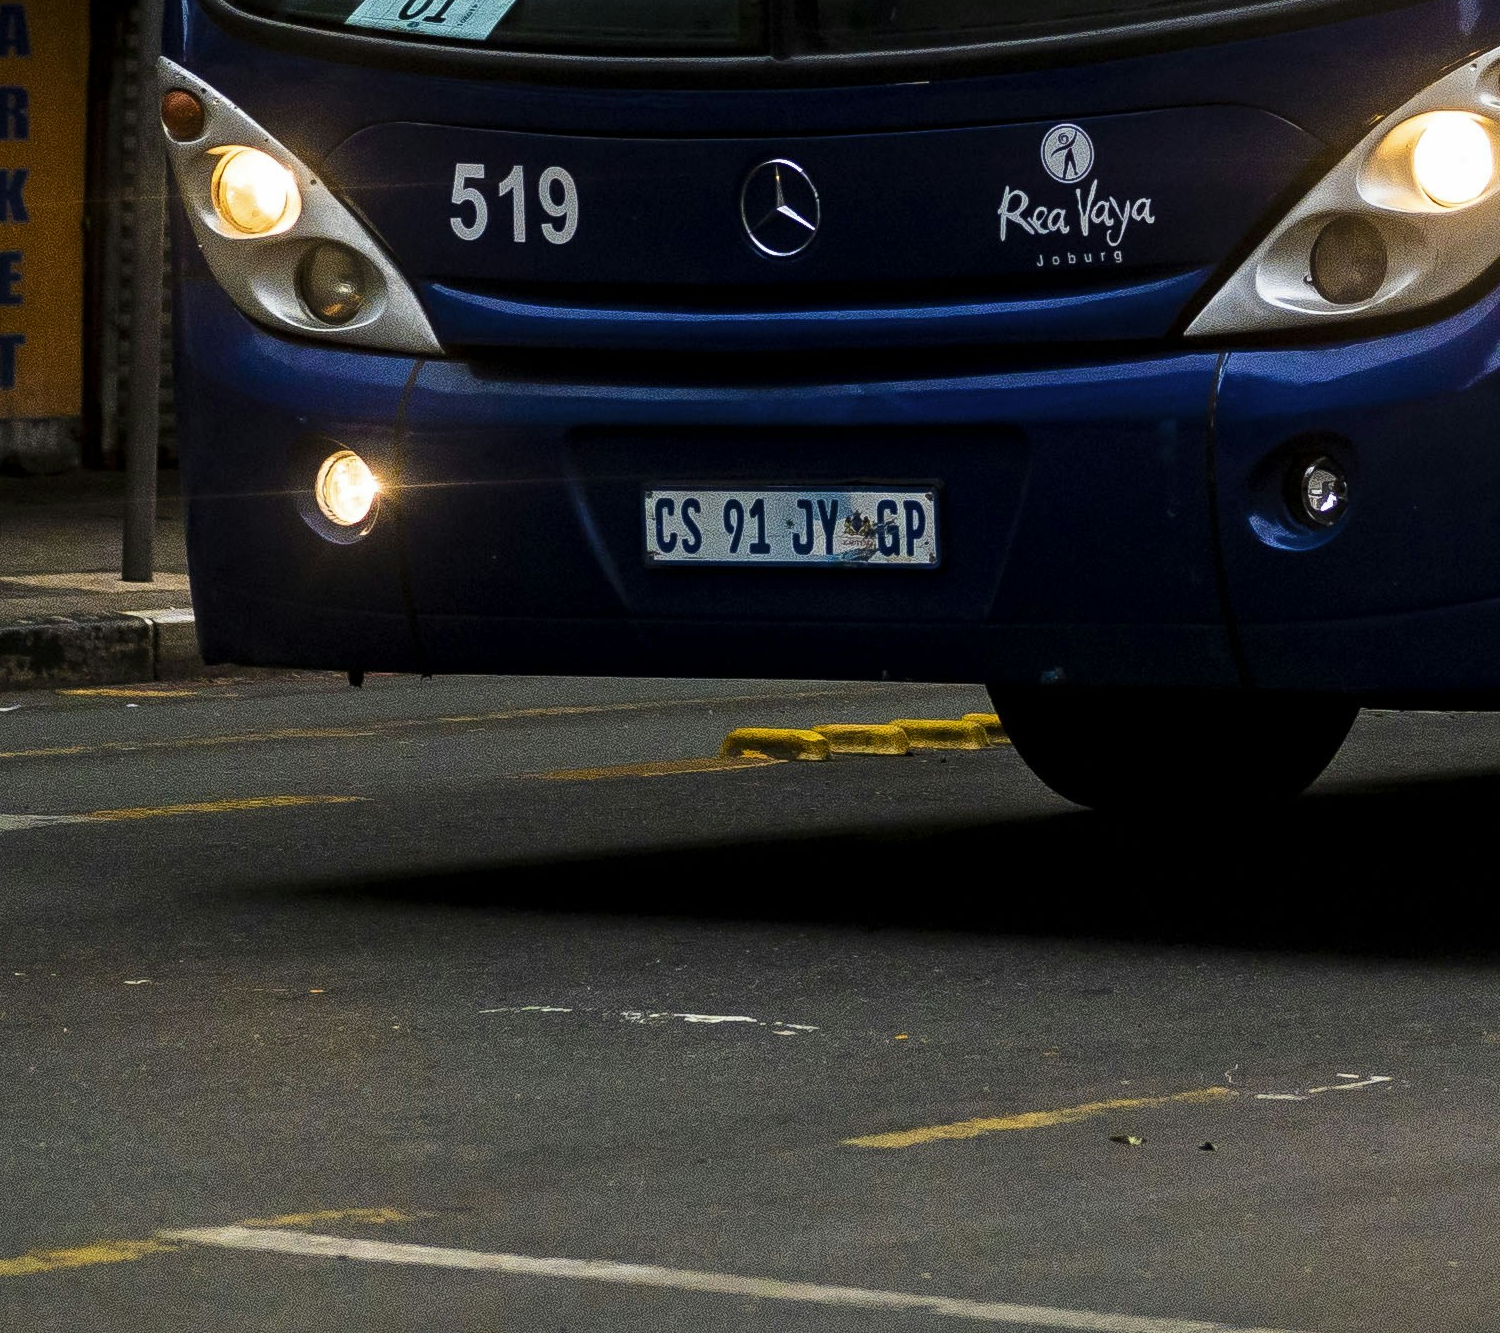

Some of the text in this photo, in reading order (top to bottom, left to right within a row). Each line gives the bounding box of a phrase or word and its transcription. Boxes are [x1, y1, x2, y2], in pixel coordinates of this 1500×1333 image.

[448, 162, 580, 246] 519
[997, 178, 1156, 247] Rea Vaya
[1035, 248, 1125, 268] Joburg
[654, 497, 926, 557] CS 91 JY GP
